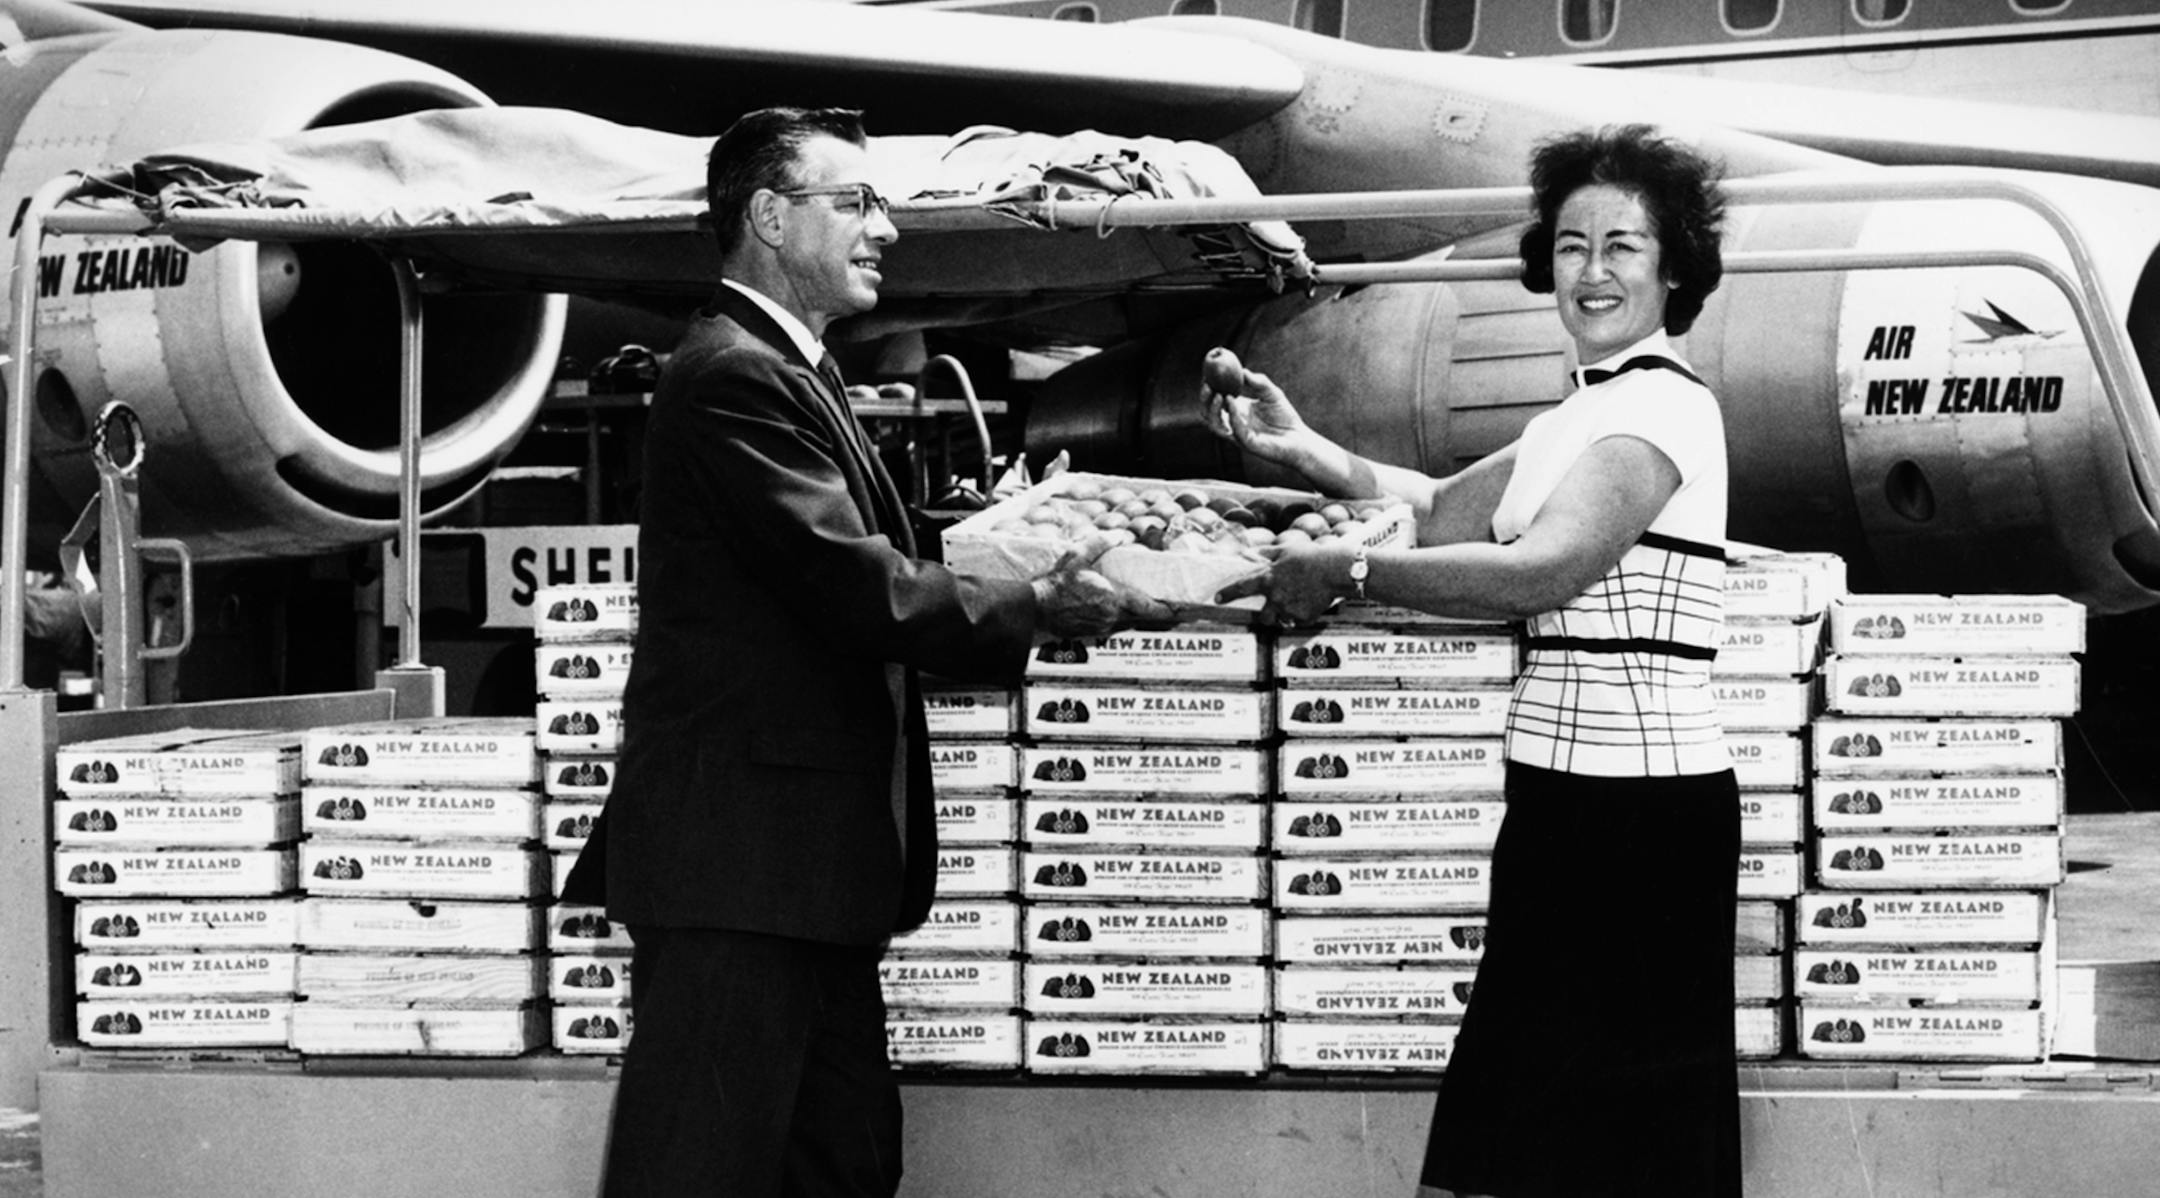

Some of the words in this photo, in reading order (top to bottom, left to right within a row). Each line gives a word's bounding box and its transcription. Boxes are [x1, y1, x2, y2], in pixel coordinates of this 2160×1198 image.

[73, 244, 189, 294] ZEALAND
[1864, 326, 1915, 360] AIR
[1865, 379, 1929, 415] NEW
[1937, 376, 2063, 413] ZEALAND
[511, 547, 637, 606] SHE
[1723, 579, 1768, 590] LAND
[1914, 613, 1953, 624] NEW
[1961, 613, 2043, 624] ZEALAND
[1096, 637, 1134, 650] NEW
[1142, 638, 1222, 650] ZEALAND
[1348, 642, 1386, 654] NEW
[1394, 641, 1477, 654] ZEALAND
[1910, 671, 1948, 682] NEW
[1957, 671, 2040, 682] ZEALAND
[1712, 688, 1766, 700] LAND
[924, 696, 975, 709] LAND
[1097, 698, 1136, 709] NEW
[1143, 698, 1224, 711] ZEALAND
[1352, 697, 1390, 709] NEW
[1398, 697, 1480, 709] ZEALAND
[1890, 731, 1929, 742] NEW
[1937, 729, 2020, 741] ZEALAND
[376, 742, 412, 752] NEW
[420, 742, 498, 753] ZEALAND
[931, 750, 977, 762] LAND
[1094, 756, 1132, 767] NEW
[1140, 756, 1221, 768] ZEALAND
[1356, 751, 1395, 763] NEW
[1403, 749, 1486, 762] ZEALAND
[126, 758, 151, 769] NE
[1890, 788, 1929, 799] NEW
[1937, 787, 2020, 799] ZEALAND
[374, 797, 410, 807] NEW
[418, 797, 495, 809] ZEALAND
[124, 807, 159, 817] NEW
[168, 807, 242, 817] ZEALAND
[1097, 808, 1136, 820] NEW
[1143, 809, 1224, 822] ZEALAND
[1350, 810, 1388, 821] NEW
[1396, 808, 1480, 821] ZEALAND
[1892, 844, 1930, 855] NEW
[1939, 843, 2022, 855] ZEALAND
[123, 859, 158, 869] NEW
[166, 858, 241, 869] ZEALAND
[371, 856, 407, 866] NEW
[415, 856, 492, 868] ZEALAND
[1094, 861, 1133, 872] NEW
[1141, 861, 1222, 873] ZEALAND
[1349, 868, 1388, 880] NEW
[1396, 867, 1479, 880] ZEALAND
[1874, 902, 1913, 913] NEW
[1921, 902, 2004, 913] ZEALAND
[147, 912, 183, 923] NEW
[191, 911, 267, 925] ZEALAND
[924, 912, 981, 924] LAND
[1099, 916, 1138, 927] NEW
[1146, 916, 1227, 927] ZEALAND
[1314, 942, 1396, 955] ZEALAND
[1404, 942, 1443, 953] NEW
[148, 961, 184, 971] NEW
[193, 958, 269, 971] ZEALAND
[1868, 959, 1907, 970] NEW
[1915, 959, 1997, 971] ZEALAND
[897, 968, 979, 980] ZEALAND
[1102, 973, 1141, 984] NEW
[1149, 973, 1231, 985] ZEALAND
[1316, 997, 1398, 1008] ZEALAND
[1406, 997, 1445, 1008] NEW
[149, 1010, 185, 1020] NEW
[194, 1009, 270, 1020] ZEALAND
[1873, 1018, 1912, 1029] NEW
[1920, 1018, 2002, 1030] ZEALAND
[904, 1026, 985, 1038] ZEALAND
[1098, 1031, 1136, 1043] NEW
[1144, 1031, 1225, 1042] ZEALAND
[1317, 1049, 1399, 1060] ZEALAND
[1407, 1049, 1446, 1060] NEW
